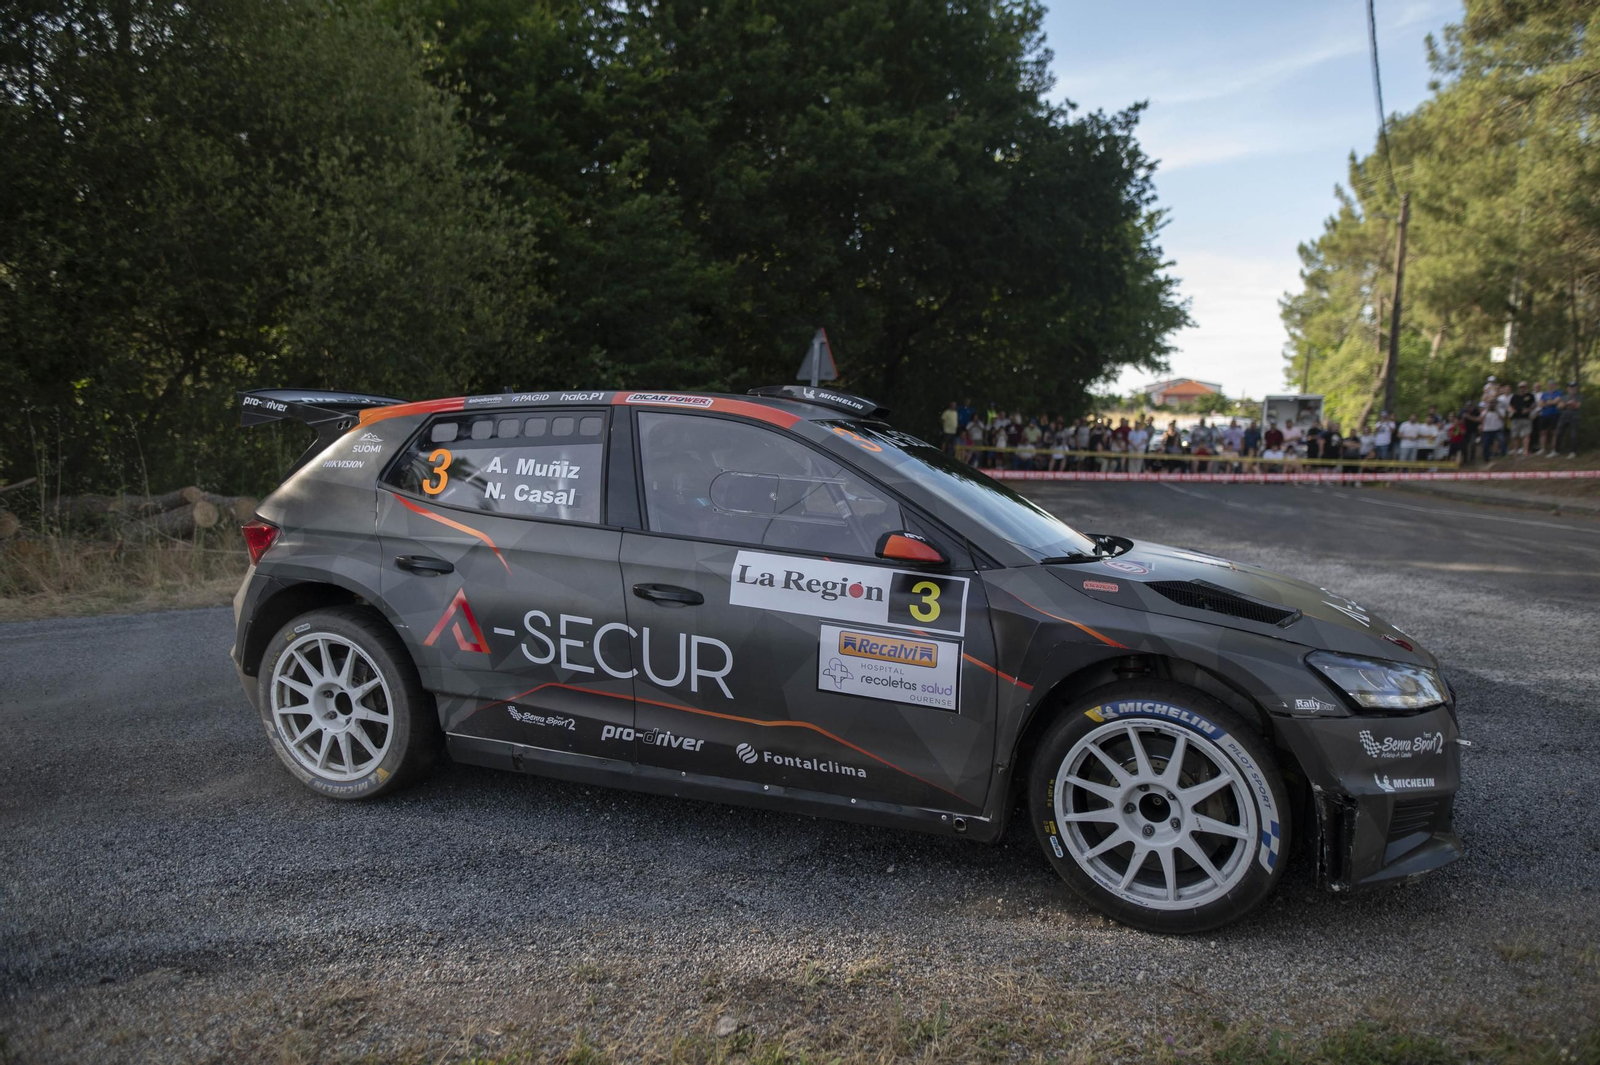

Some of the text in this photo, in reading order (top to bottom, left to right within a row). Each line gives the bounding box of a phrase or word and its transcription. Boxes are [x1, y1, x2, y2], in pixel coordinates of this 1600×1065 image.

[519, 394, 550, 402] PAGID
[560, 392, 605, 401] halo.P1
[818, 392, 864, 410] MICHELIN
[352, 444, 382, 453] SUOMI
[322, 460, 365, 469] HIKVISION
[422, 448, 453, 495] 3
[486, 456, 581, 479] A. Muñiz
[484, 481, 576, 506] N. Casal
[736, 564, 884, 602] La Región
[909, 581, 942, 623] 3
[857, 638, 919, 661] Recalvi
[860, 662, 905, 676] HOSPITAL
[860, 674, 953, 697] recoletas salud
[909, 694, 953, 707] OURENSE
[1118, 702, 1217, 735] MICHELIN
[601, 724, 704, 752] pro-driver
[1381, 737, 1412, 752] Senra
[763, 751, 868, 779] Fontalclima
[1228, 743, 1272, 811] PILOT SPORT
[1392, 778, 1435, 788] MICHELIN
